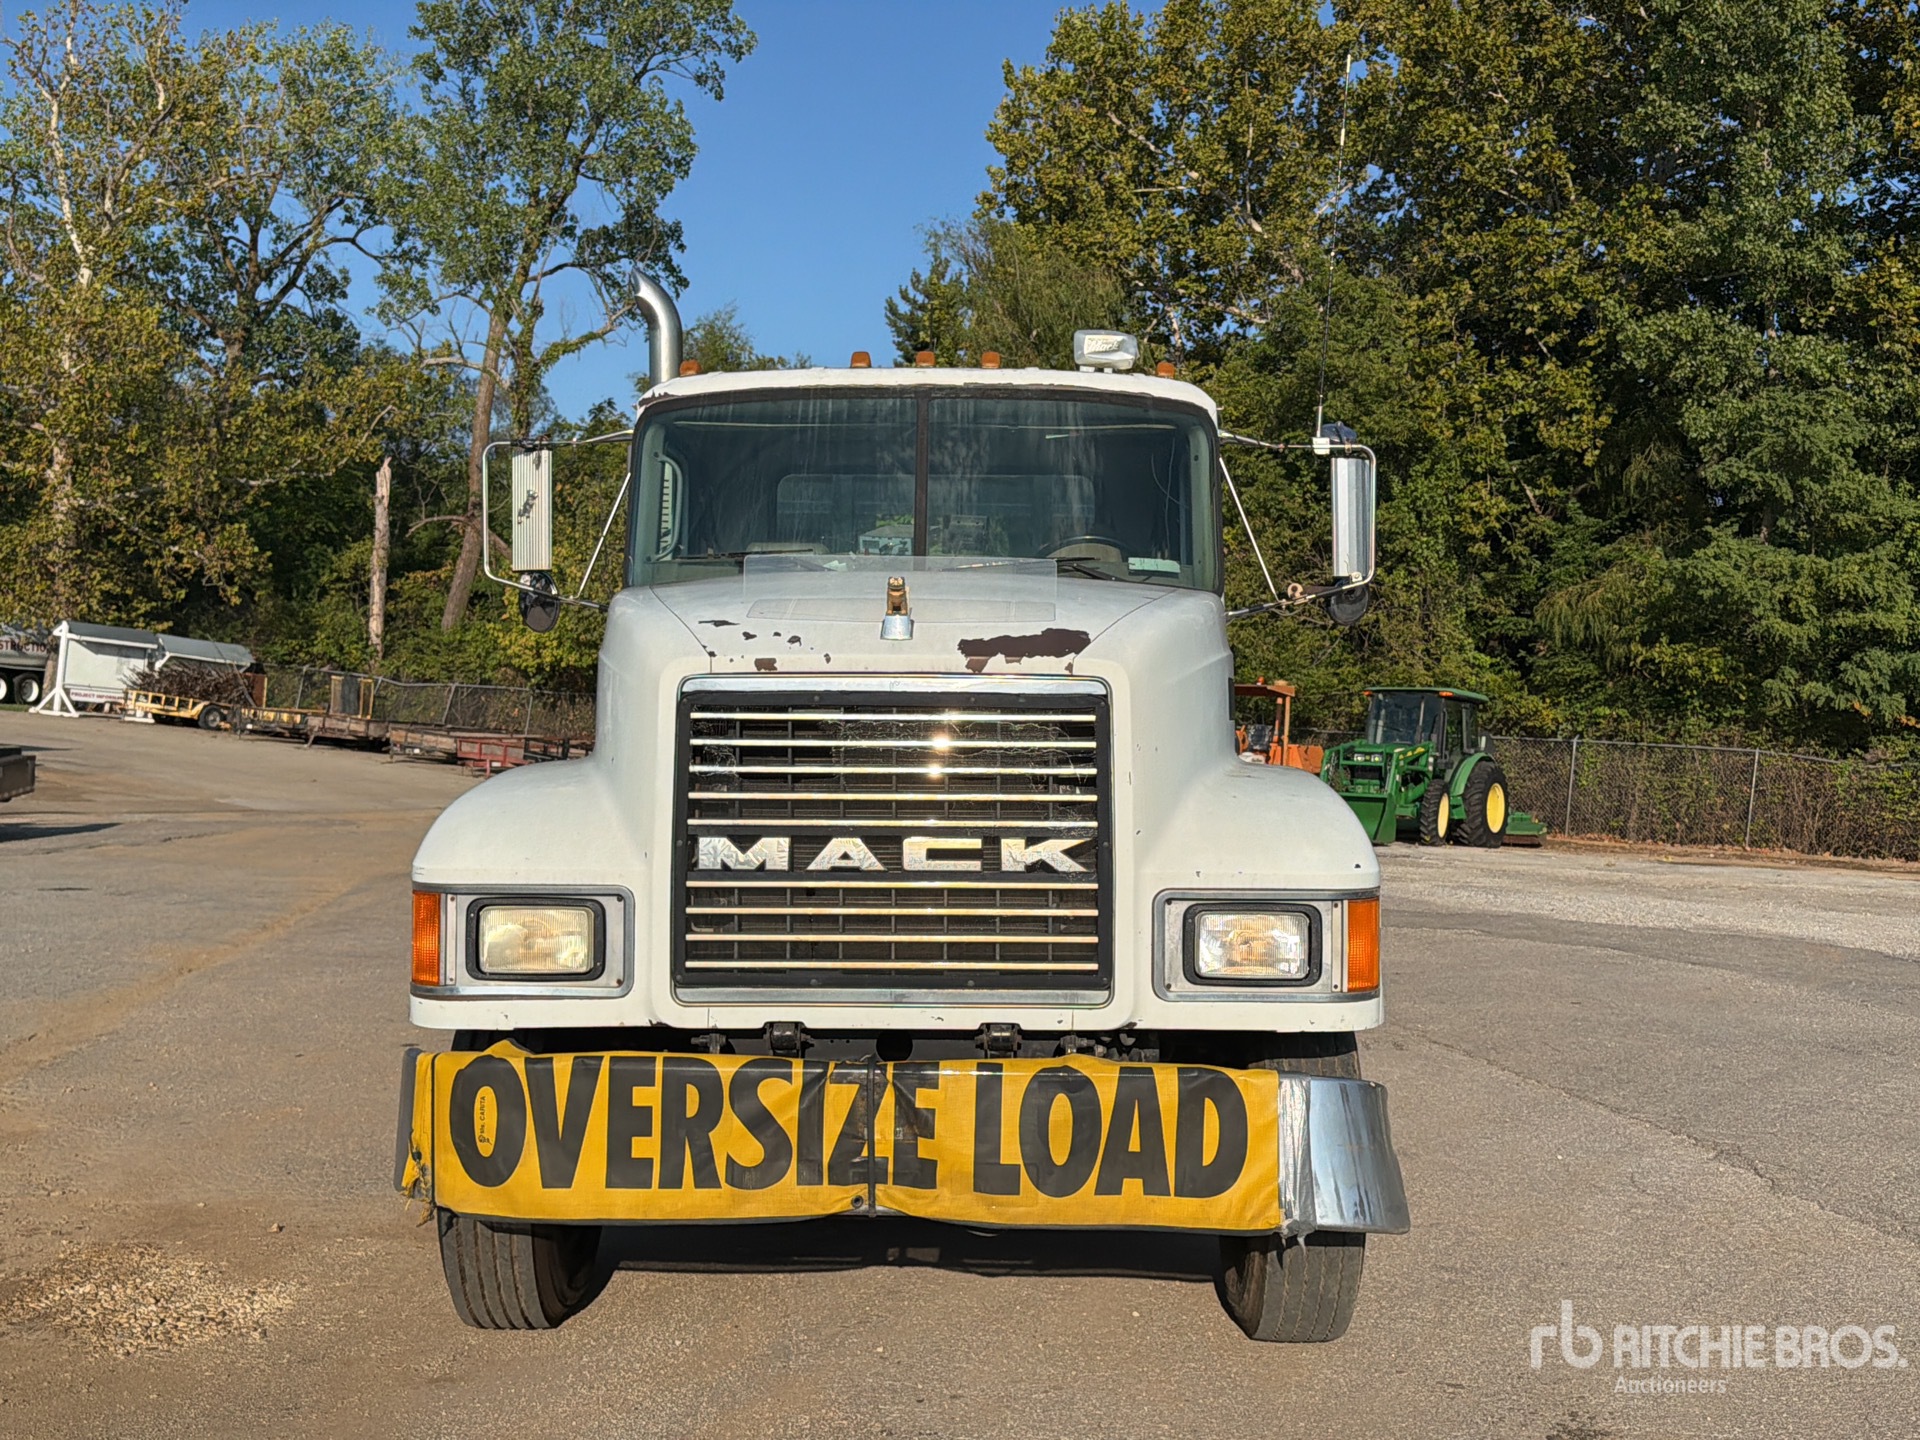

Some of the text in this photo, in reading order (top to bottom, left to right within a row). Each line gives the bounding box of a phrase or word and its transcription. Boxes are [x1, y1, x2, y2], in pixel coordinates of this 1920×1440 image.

[698, 836, 1094, 873] MACK
[450, 1054, 1248, 1198] OVERSIZE LOAD
